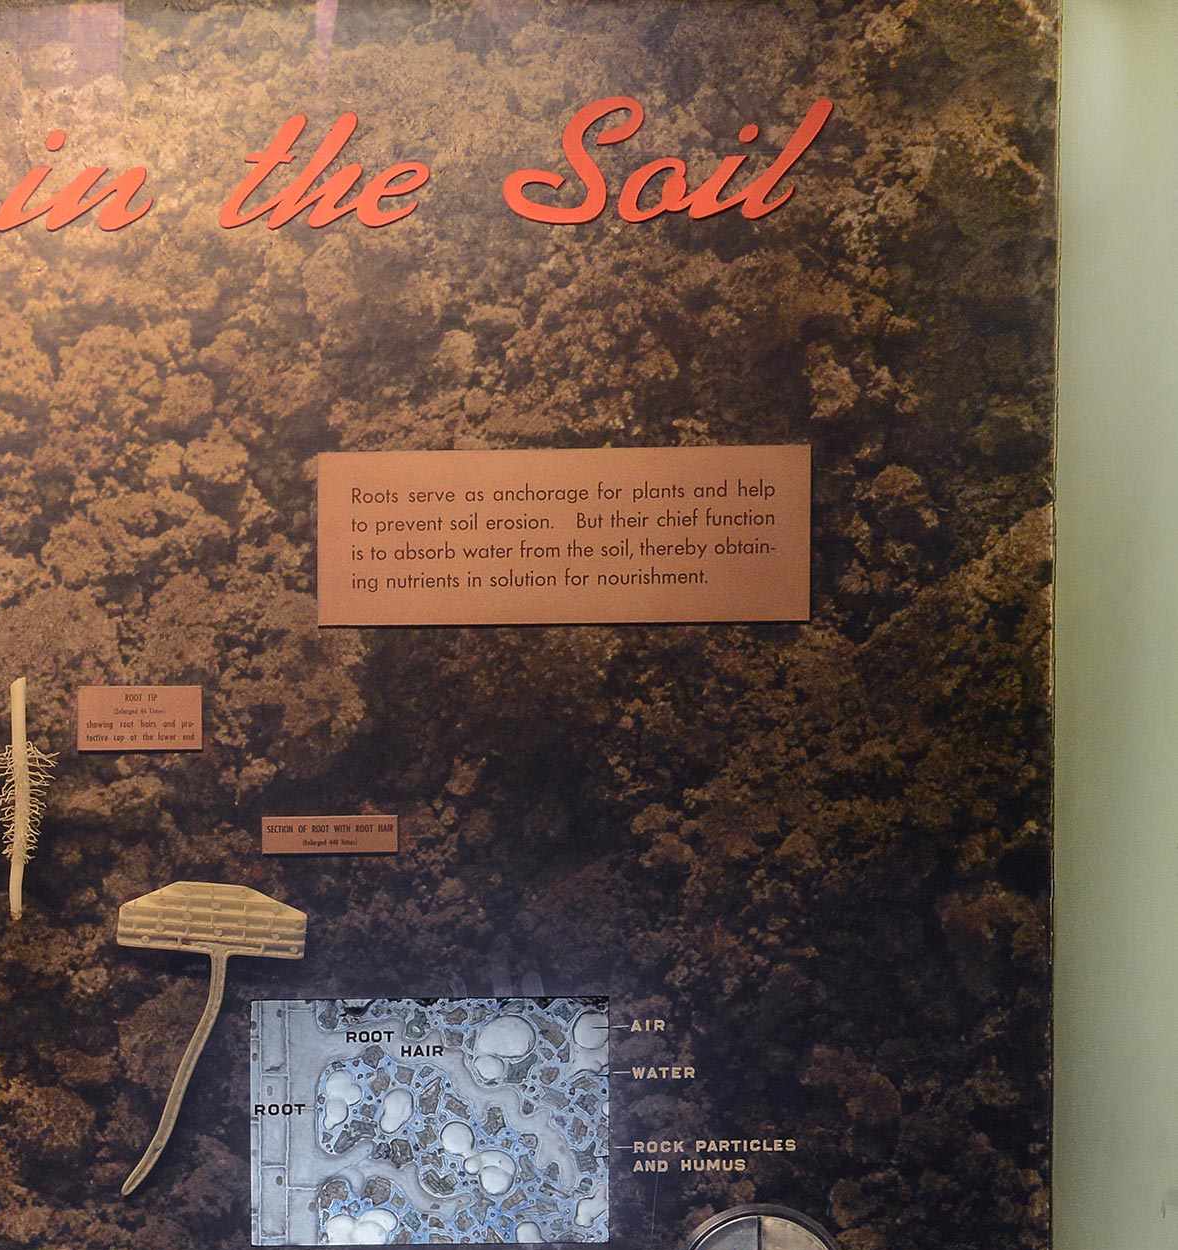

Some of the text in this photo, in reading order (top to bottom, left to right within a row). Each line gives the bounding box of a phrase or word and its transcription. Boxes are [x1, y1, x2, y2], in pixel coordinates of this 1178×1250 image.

[221, 112, 431, 231] the
[504, 96, 835, 225] Soil
[352, 479, 775, 504] Roots serve as anchorage for plants and help
[352, 508, 774, 534] to prevent soil erosion. But their chief function
[352, 536, 775, 560] is to absorb water from the soil, thereby obtain-
[353, 566, 707, 592] ing nutrients in solution for nourishment.
[267, 825, 293, 833] SECTION
[298, 825, 307, 833] OF
[312, 825, 329, 833] ROOT
[356, 825, 373, 833] ROOT
[378, 824, 393, 832] HAIR
[631, 1019, 666, 1031] AIR
[346, 1031, 395, 1043] ROOT
[401, 1045, 444, 1057] HAIR
[632, 1066, 696, 1079] WATER
[255, 1104, 306, 1116] ROOT
[633, 1138, 798, 1153] ROCK PARTICLES
[633, 1158, 747, 1172] AND HUMUS
